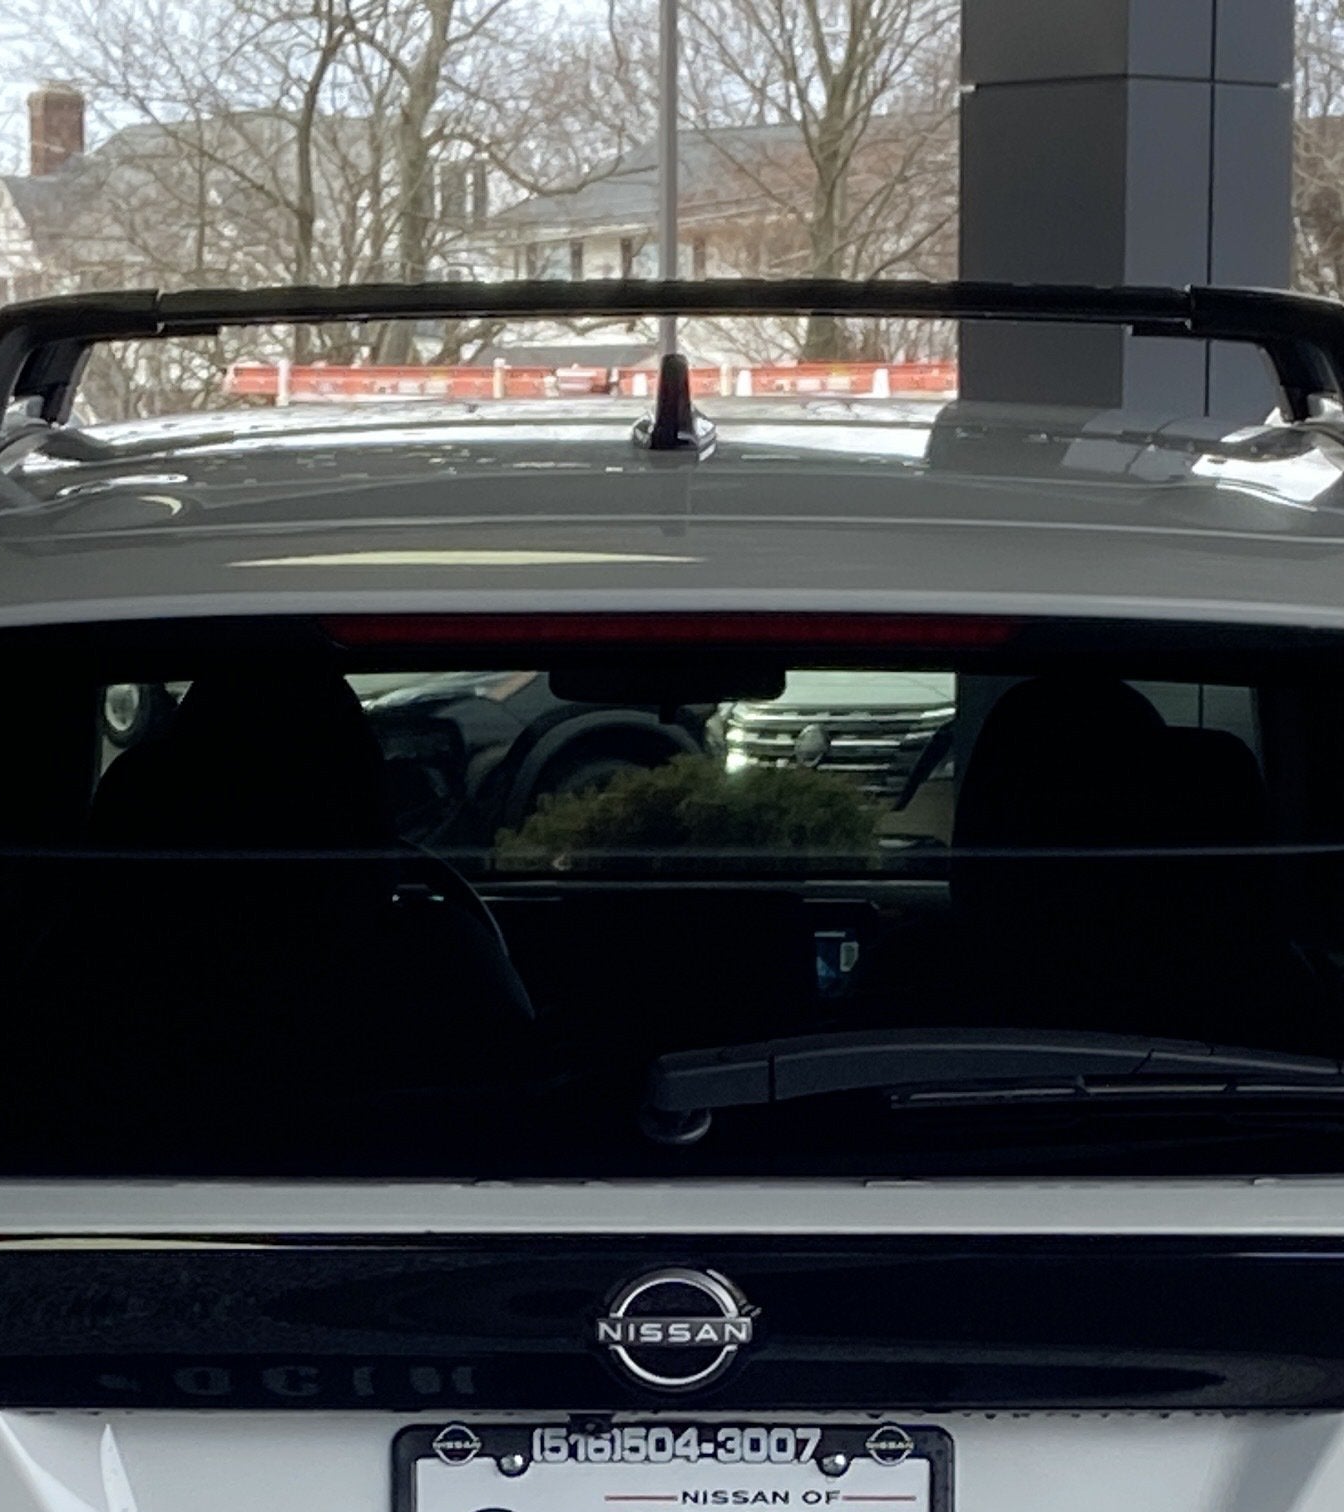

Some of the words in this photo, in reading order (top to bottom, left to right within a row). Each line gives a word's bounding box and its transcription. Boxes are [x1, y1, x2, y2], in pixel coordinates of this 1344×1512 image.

[597, 1321, 749, 1343] NISSAN
[532, 1427, 822, 1463] (516)504-3007
[681, 1490, 790, 1505] NISSAN
[801, 1490, 840, 1505] OF
